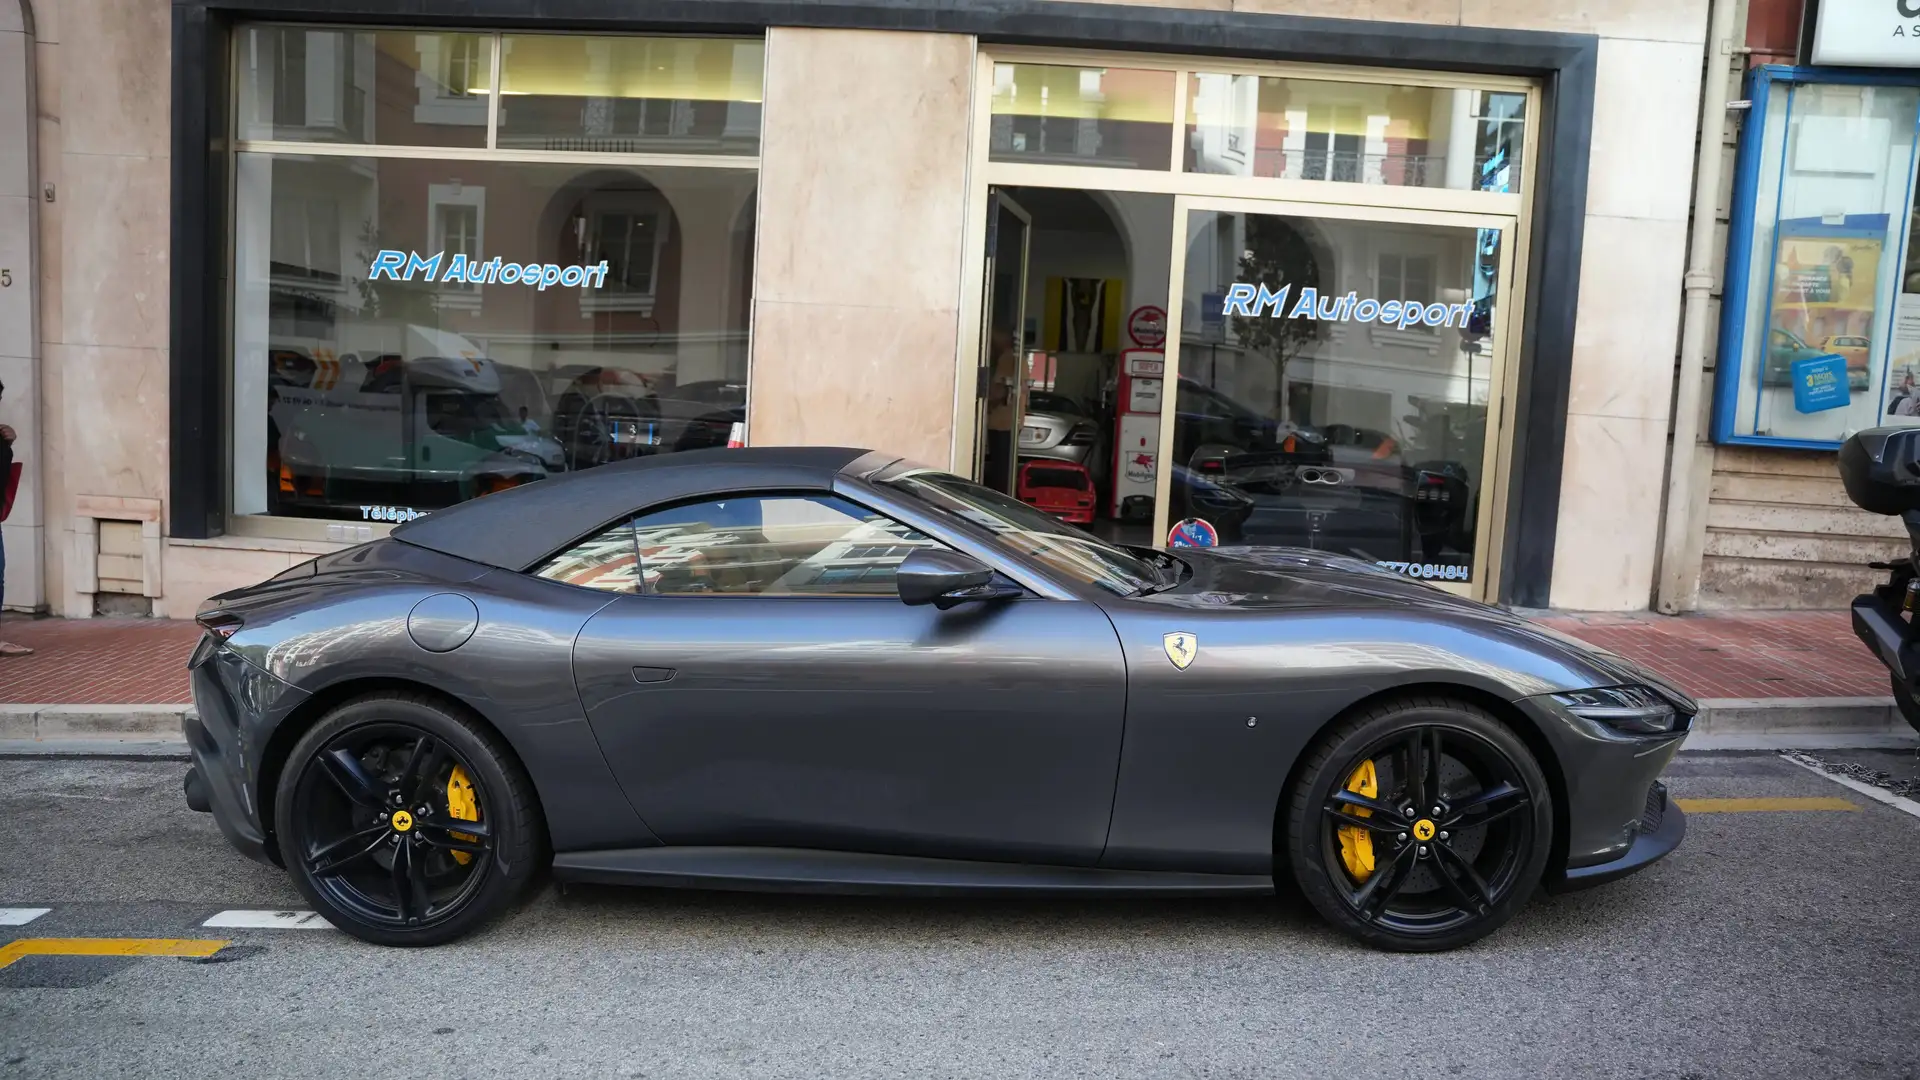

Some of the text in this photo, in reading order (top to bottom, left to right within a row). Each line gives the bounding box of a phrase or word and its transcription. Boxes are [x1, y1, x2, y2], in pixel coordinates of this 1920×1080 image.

[368, 249, 609, 291] RM Autosport
[1222, 282, 1476, 330] RM Autosport
[360, 505, 432, 523] Téléph
